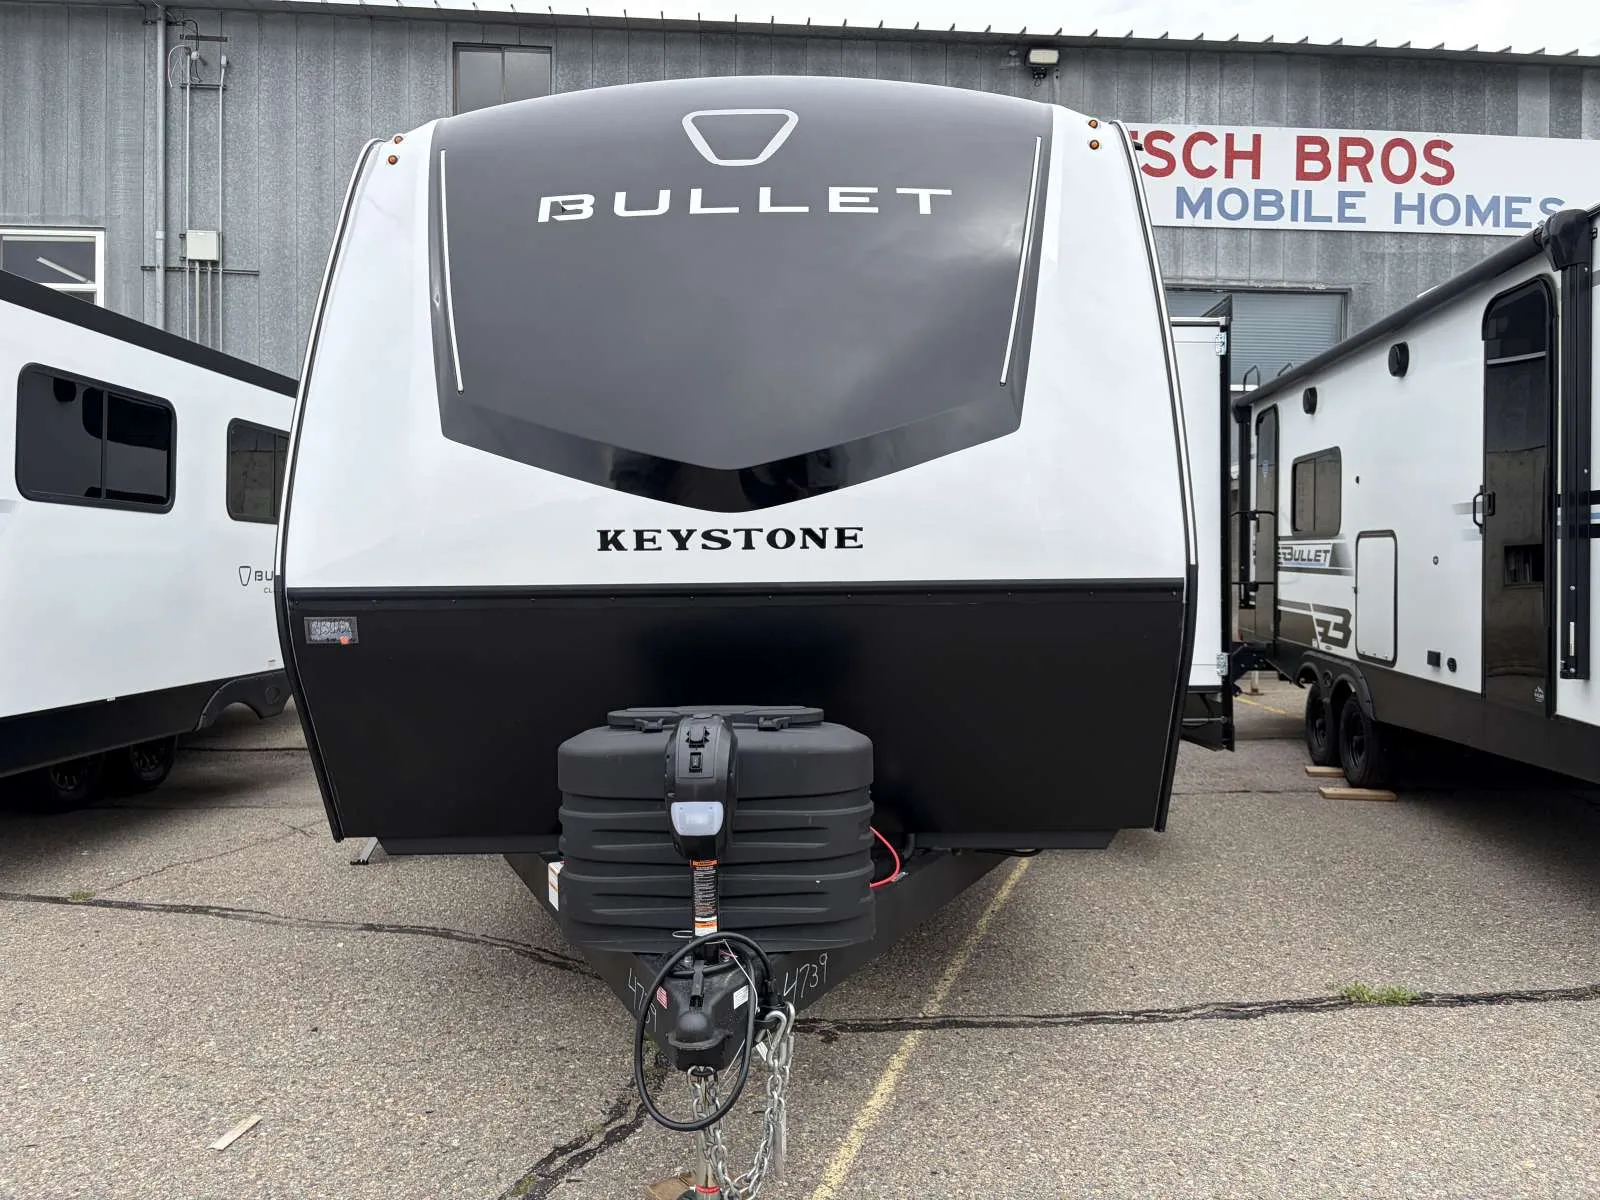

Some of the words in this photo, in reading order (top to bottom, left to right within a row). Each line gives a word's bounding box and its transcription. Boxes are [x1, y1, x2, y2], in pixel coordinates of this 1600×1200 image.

[1295, 135, 1455, 186] BROS
[537, 186, 953, 223] BULLET
[1175, 186, 1367, 224] MOBILE
[597, 527, 864, 551] KEYSTONE
[783, 952, 828, 1005] 4739
